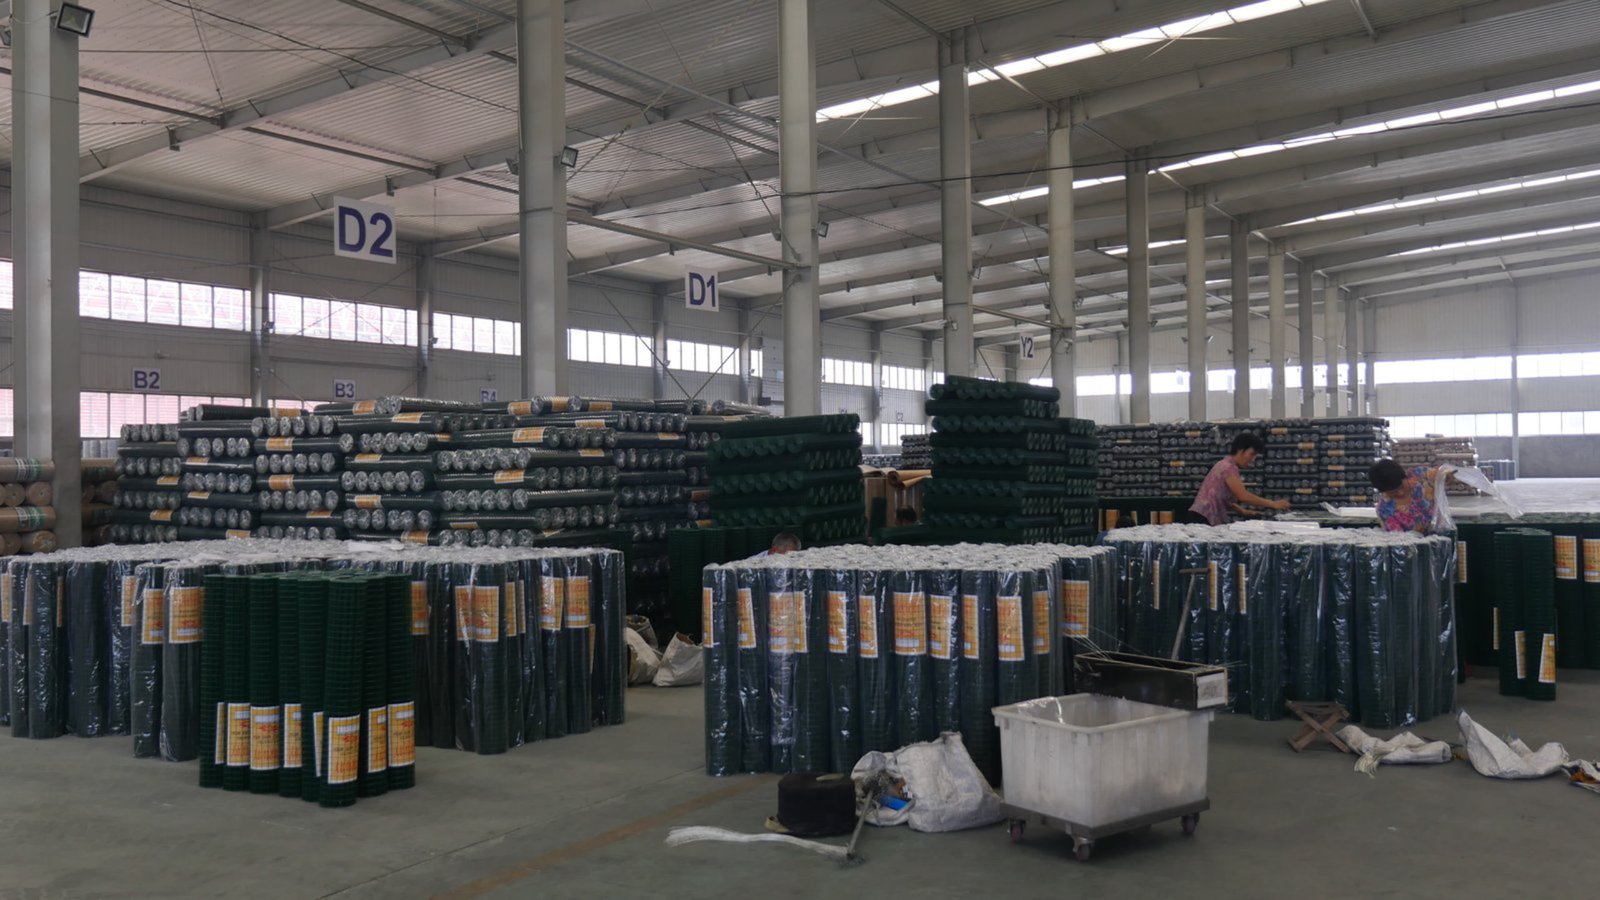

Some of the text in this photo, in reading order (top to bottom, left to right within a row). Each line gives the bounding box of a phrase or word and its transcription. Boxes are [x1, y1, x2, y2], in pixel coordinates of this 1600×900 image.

[338, 205, 393, 258] D2
[689, 271, 716, 308] D1
[1020, 335, 1034, 358] Y2
[134, 370, 160, 390] B2
[335, 382, 355, 398] B3
